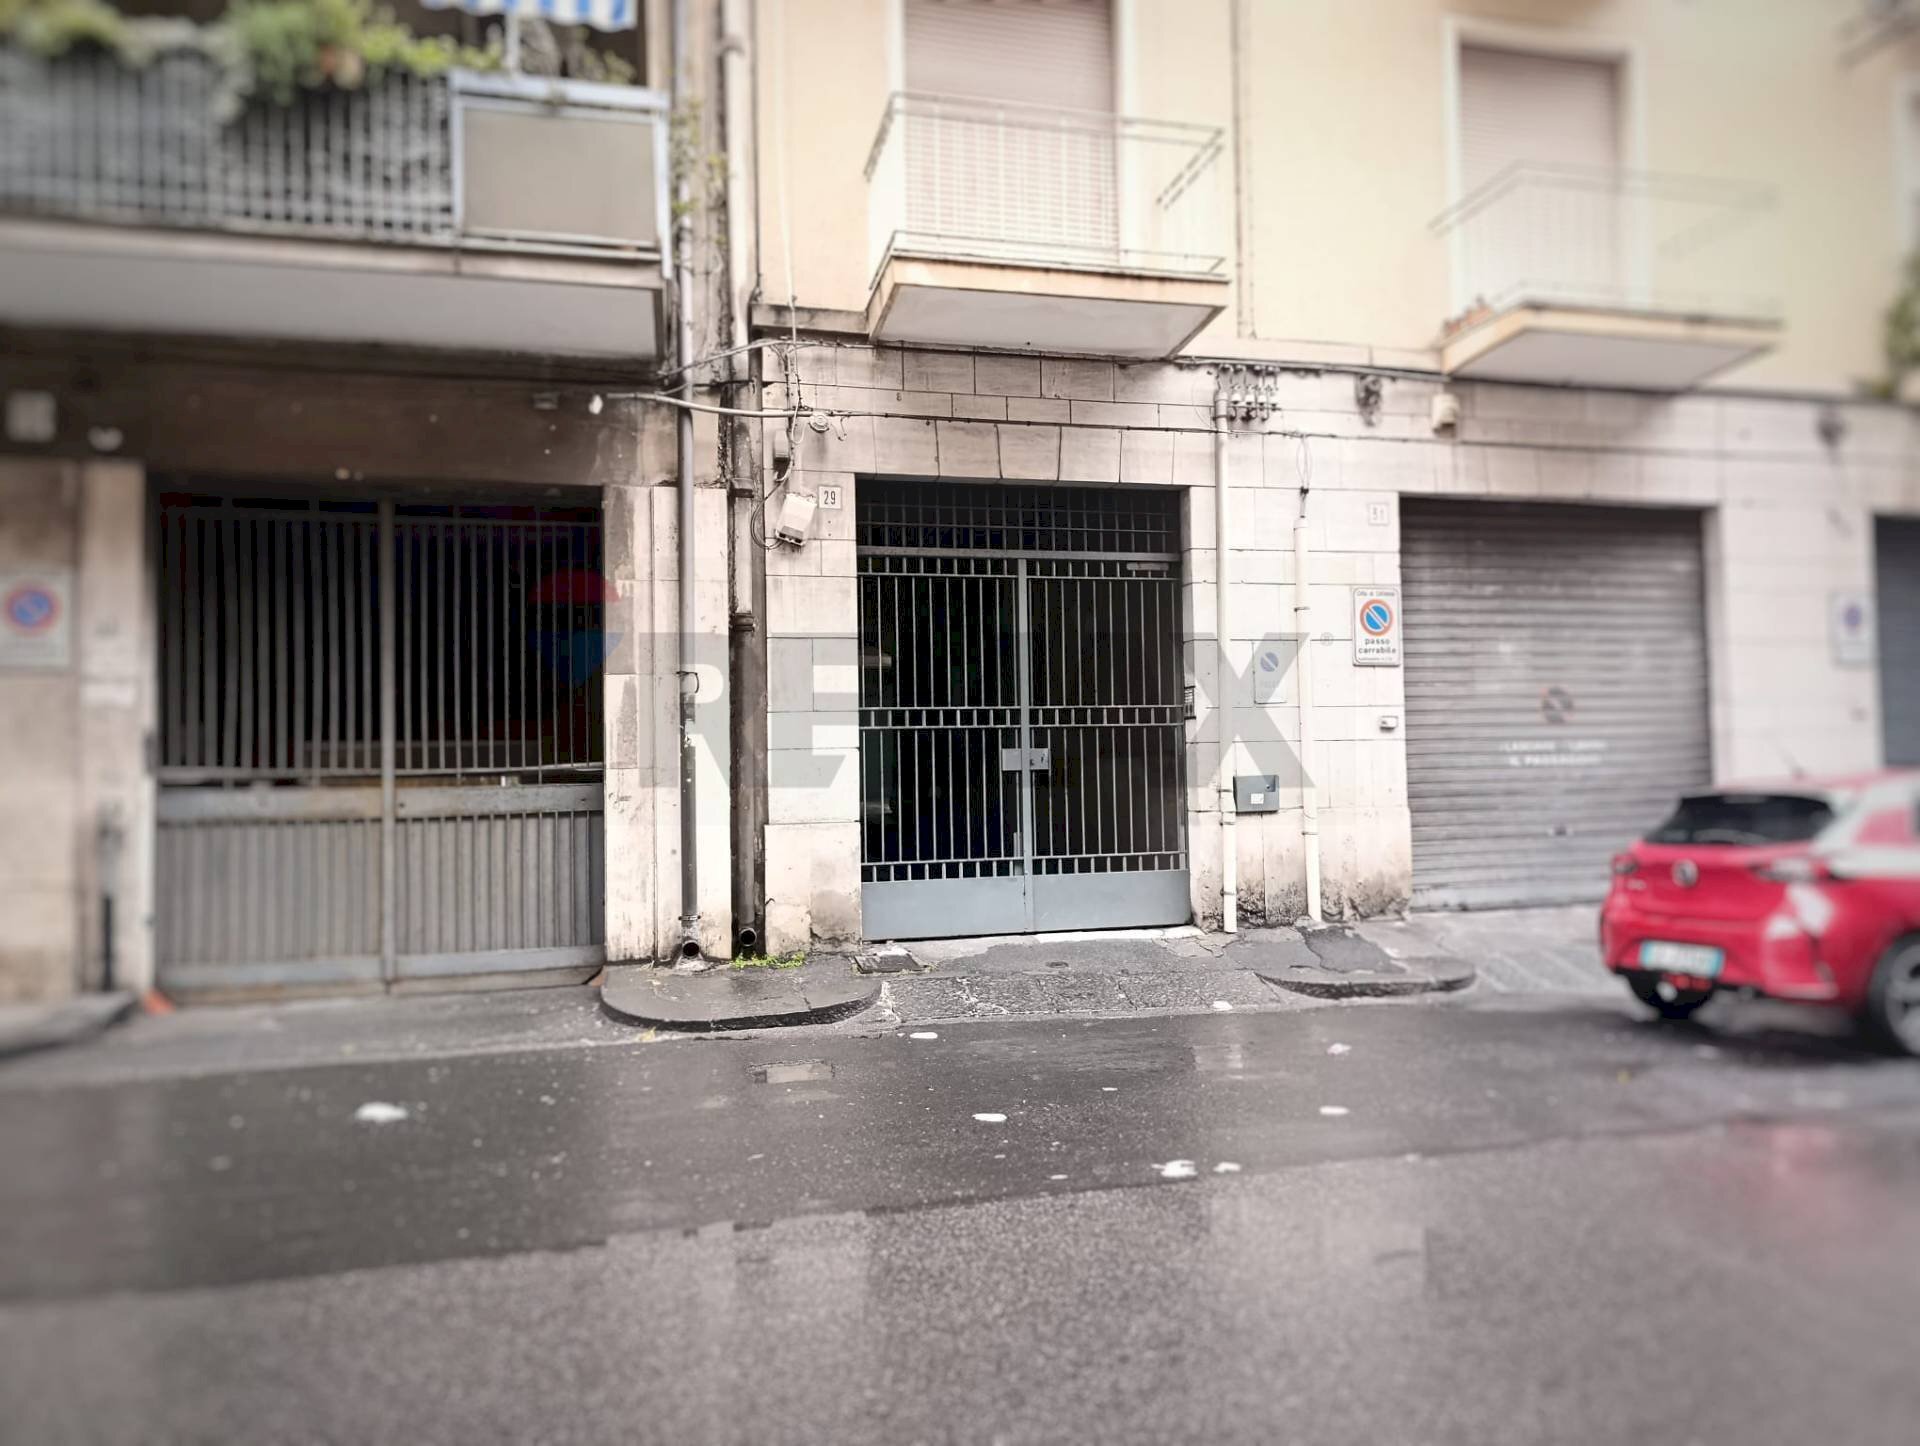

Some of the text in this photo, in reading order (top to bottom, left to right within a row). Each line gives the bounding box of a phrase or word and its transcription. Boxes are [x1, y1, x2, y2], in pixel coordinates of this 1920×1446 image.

[823, 490, 836, 505] 29
[1364, 638, 1390, 646] passo
[1358, 646, 1396, 654] carrabile
